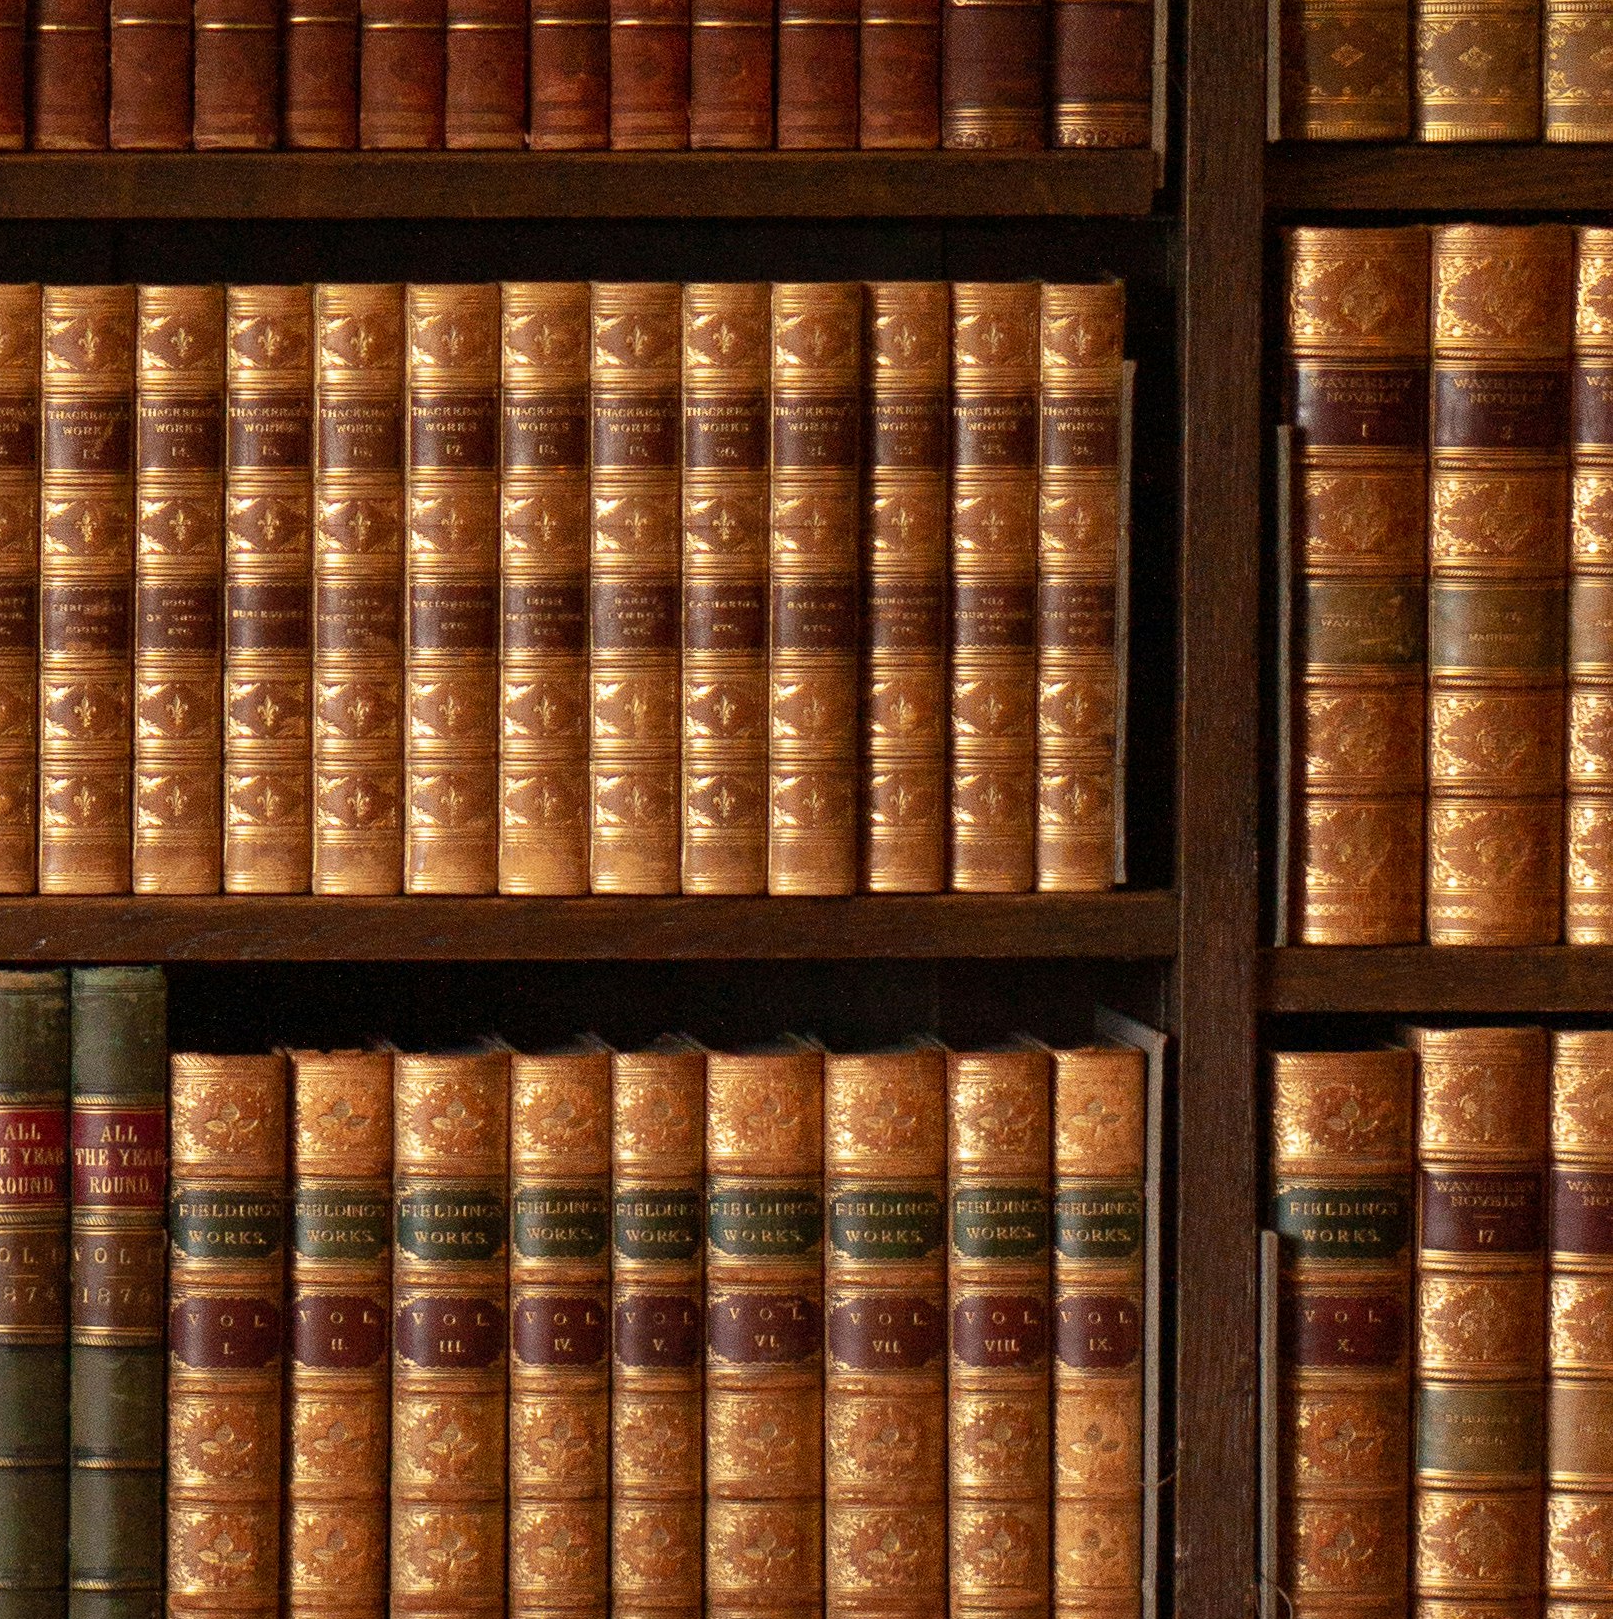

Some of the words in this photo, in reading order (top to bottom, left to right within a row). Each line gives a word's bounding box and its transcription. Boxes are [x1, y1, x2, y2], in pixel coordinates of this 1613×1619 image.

[424, 421, 477, 432] WORKS
[699, 421, 749, 433] WORKS
[4, 1123, 41, 1141] ALL
[100, 1125, 137, 1143] ALL
[22, 1147, 65, 1165] YEAR
[74, 1148, 109, 1167] THE
[118, 1149, 162, 1166] YEAR
[89, 1176, 152, 1194] ROUND.
[187, 1231, 267, 1245] WORKS.
[306, 1230, 375, 1244] WORKS.
[526, 1227, 594, 1241] WORKS.
[625, 1229, 693, 1242] WORKS.
[724, 1229, 805, 1243] WORKS.
[845, 1229, 924, 1244] WORKS.
[966, 1227, 1035, 1241] WORKS.
[1061, 1228, 1132, 1242] WORKS.
[1302, 1229, 1381, 1243] WORKS.
